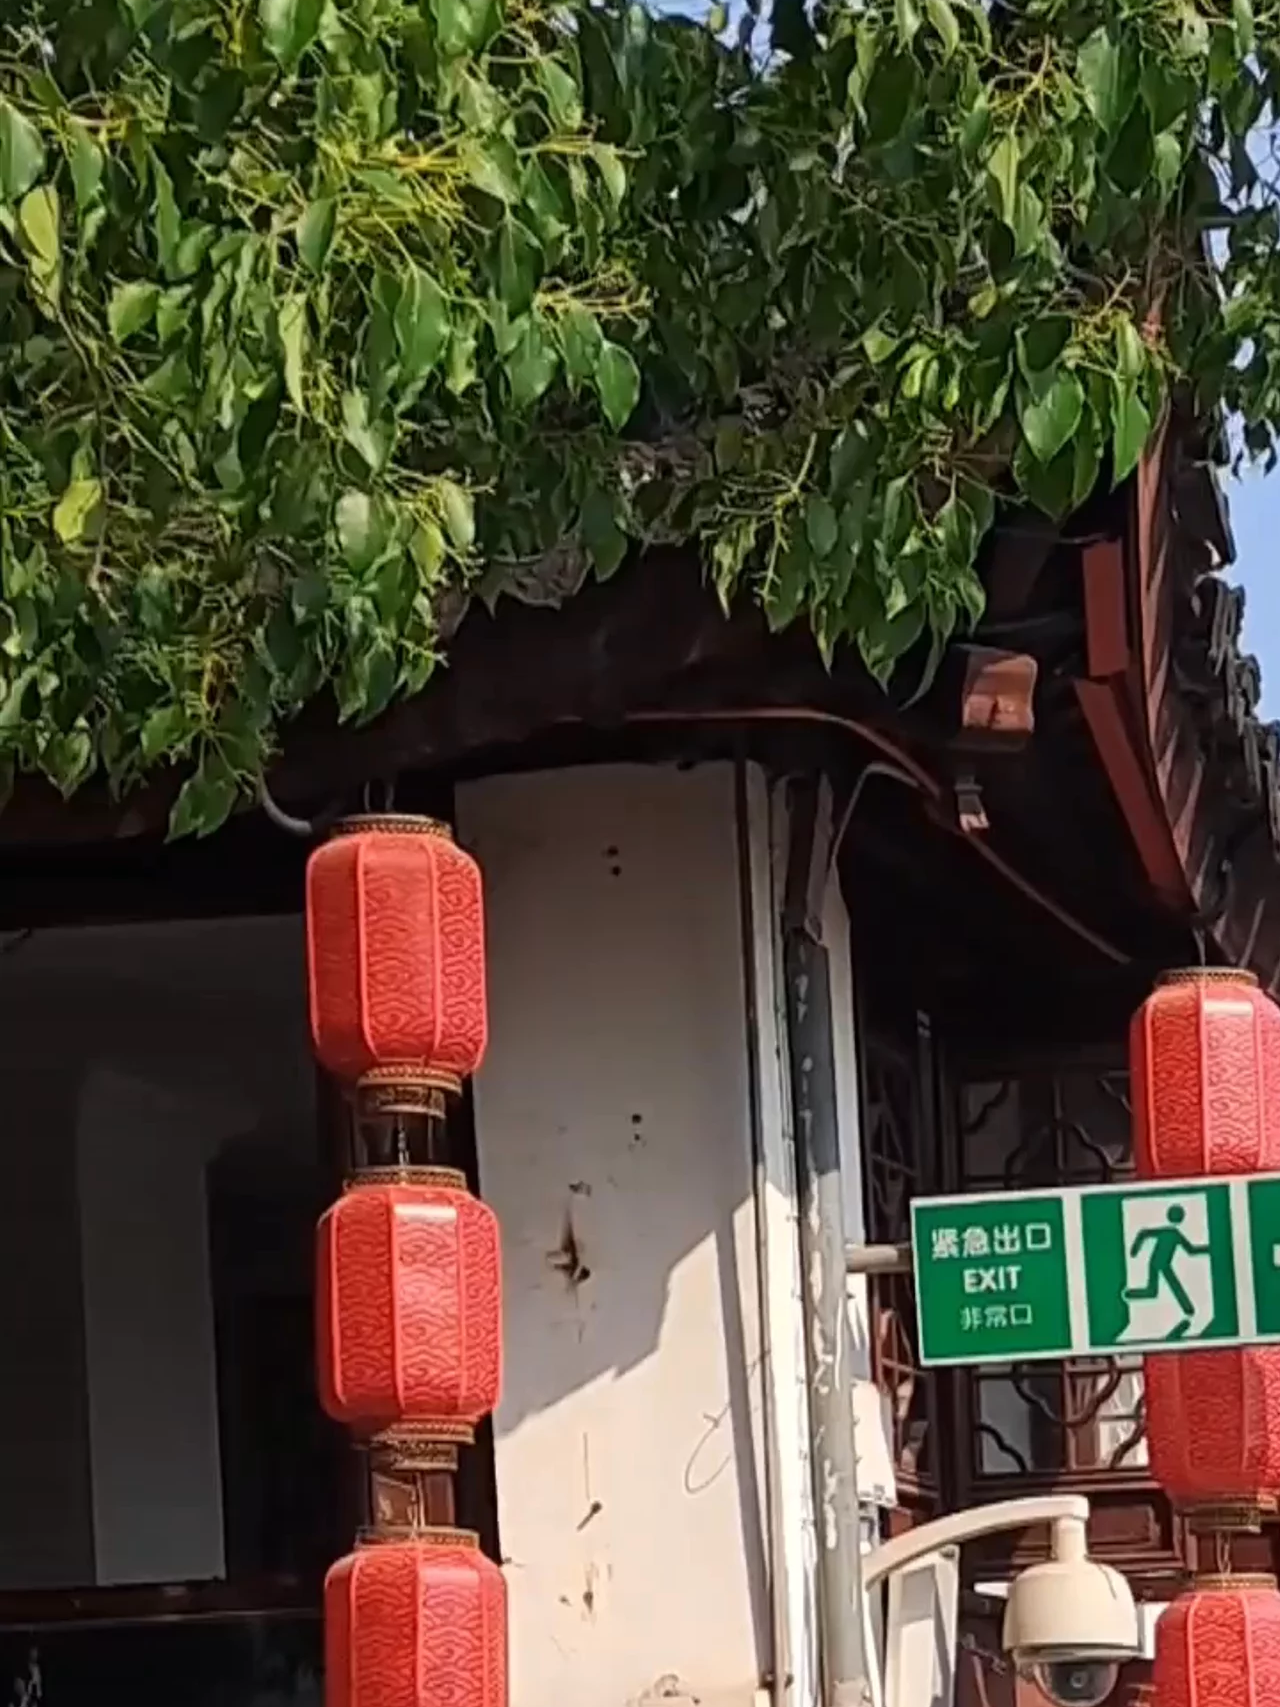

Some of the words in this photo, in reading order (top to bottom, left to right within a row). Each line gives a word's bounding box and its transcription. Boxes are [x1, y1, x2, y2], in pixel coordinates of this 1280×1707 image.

[930, 1222, 1053, 1260] 紧急出口
[962, 1266, 1022, 1293] EXIT
[960, 1303, 1033, 1331] 非常口
